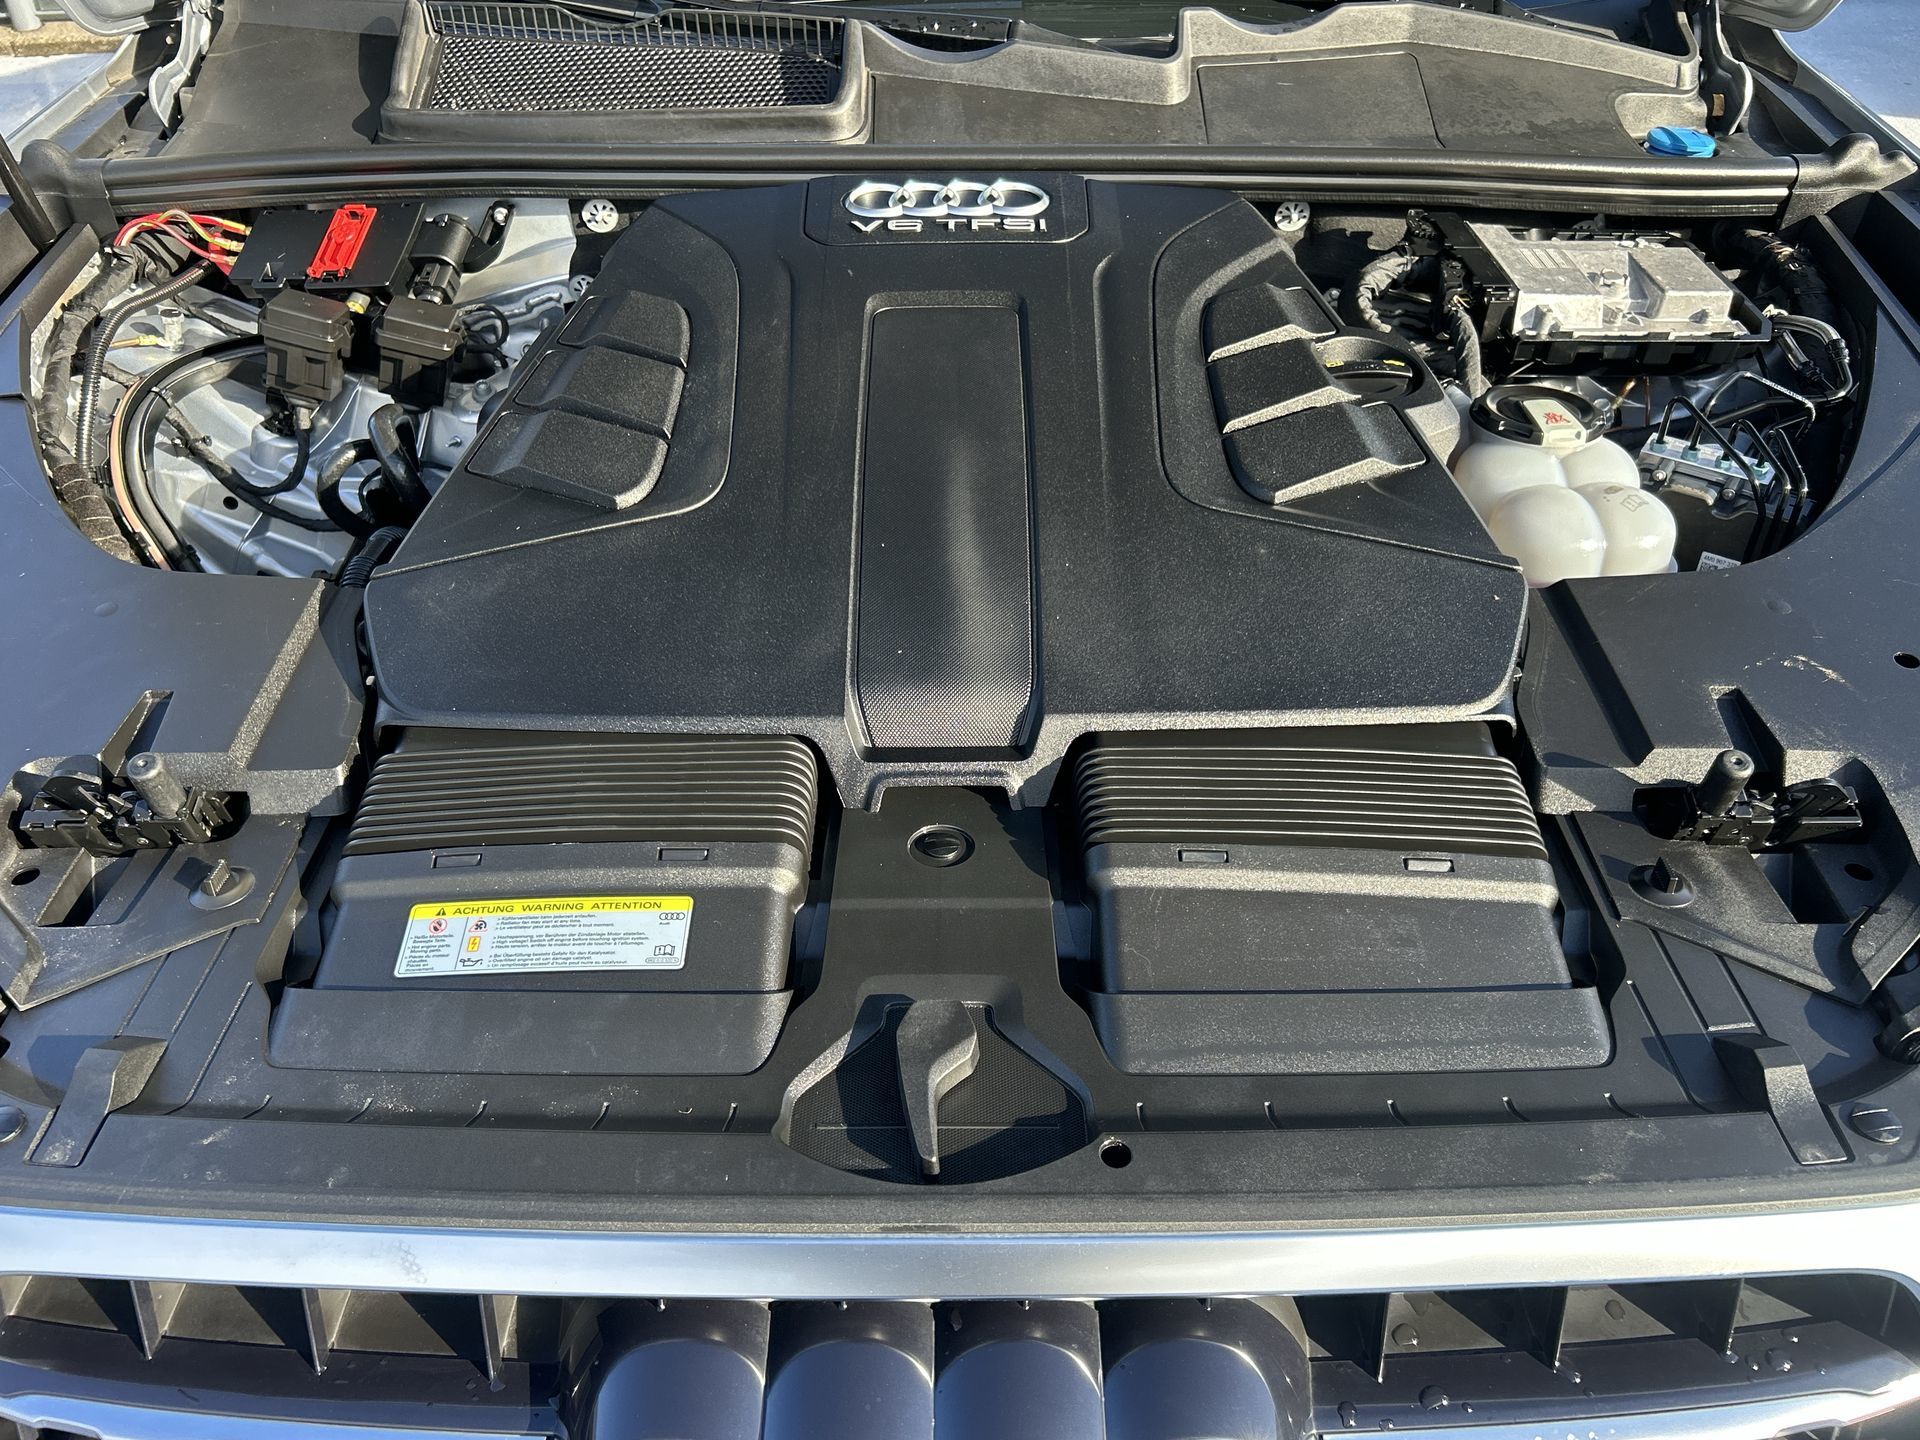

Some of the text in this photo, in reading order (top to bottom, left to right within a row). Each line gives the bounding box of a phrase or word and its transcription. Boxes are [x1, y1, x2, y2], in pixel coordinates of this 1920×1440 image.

[850, 218, 1048, 232] V6 TFSI
[453, 901, 662, 916] ACHTUNG WARNING ATTENTION
